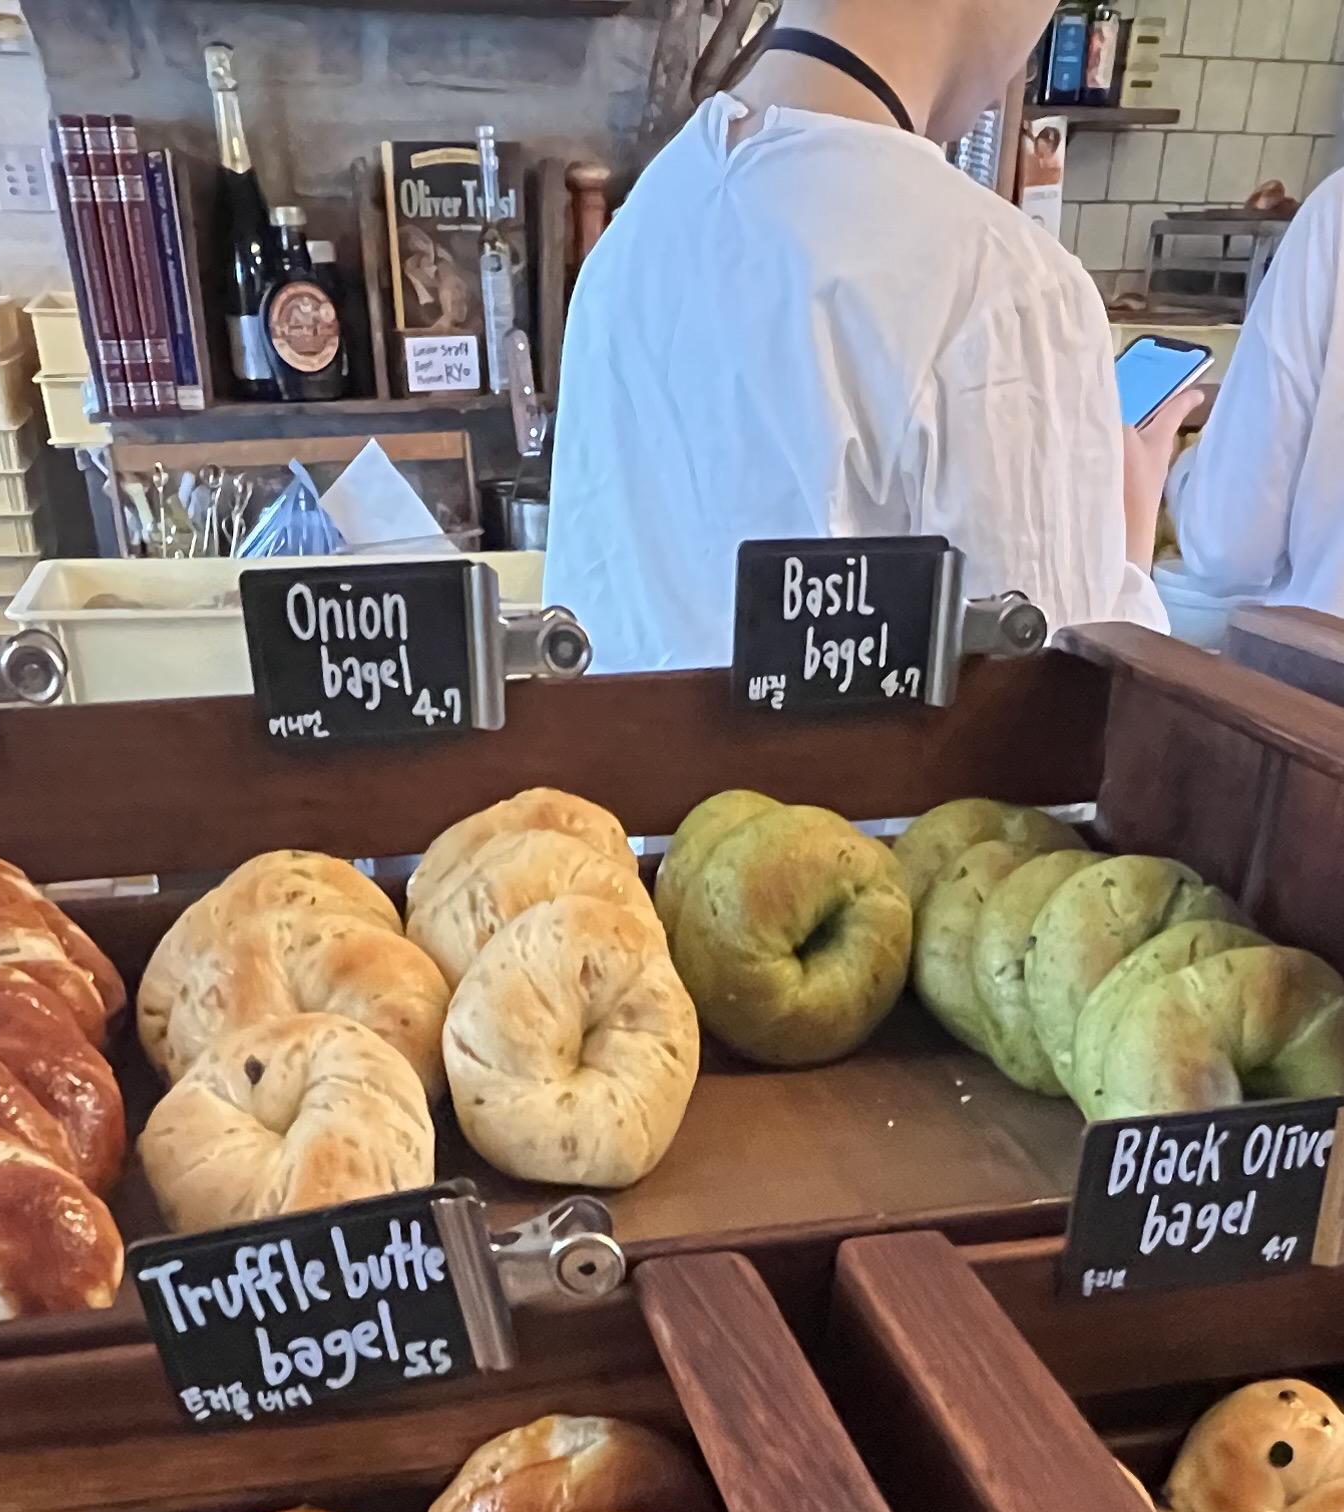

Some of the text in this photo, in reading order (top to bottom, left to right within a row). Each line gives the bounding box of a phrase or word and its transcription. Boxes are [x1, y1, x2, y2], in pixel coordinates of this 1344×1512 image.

[401, 179, 463, 218] Oliver
[286, 583, 408, 642] Onion
[783, 554, 875, 621] Basil
[320, 644, 413, 711] bagel
[803, 622, 888, 693] bagel
[748, 674, 787, 710] 바질
[1107, 1121, 1231, 1196] Black
[1139, 1190, 1257, 1255] bagel
[138, 1238, 331, 1333] Truffle
[255, 1299, 400, 1390] bagel
